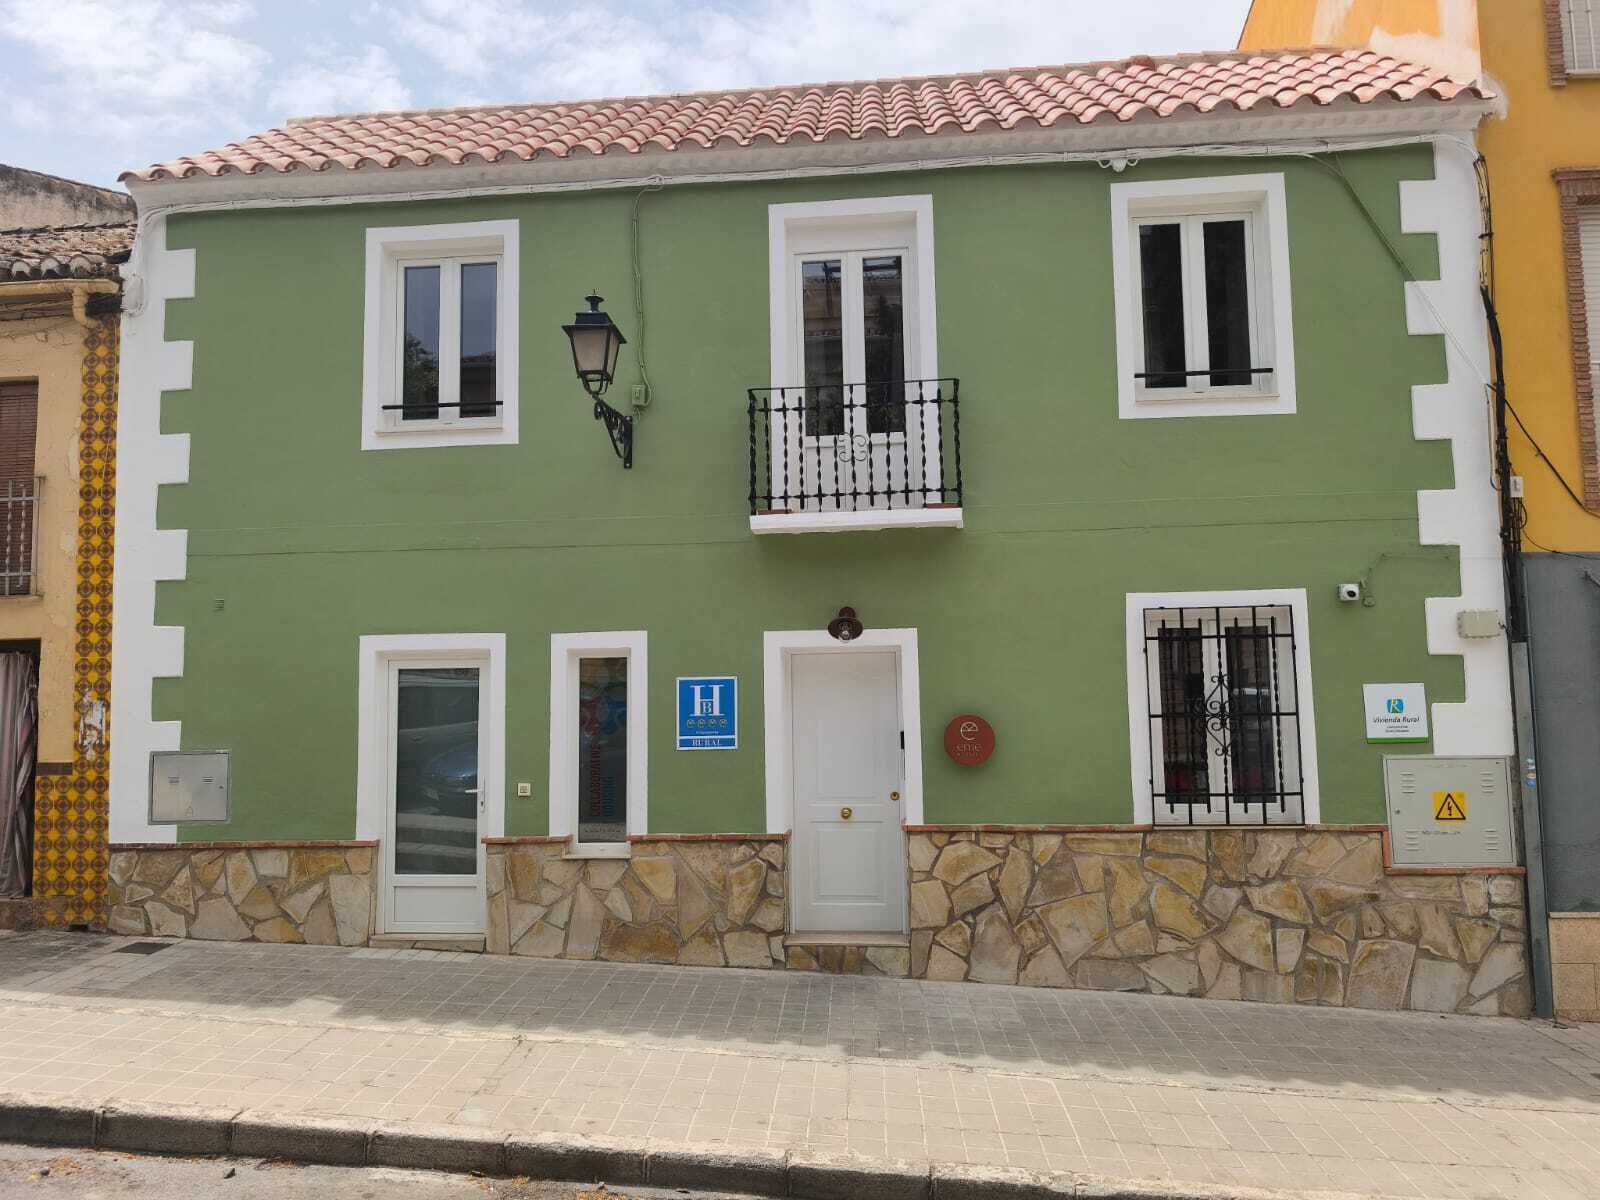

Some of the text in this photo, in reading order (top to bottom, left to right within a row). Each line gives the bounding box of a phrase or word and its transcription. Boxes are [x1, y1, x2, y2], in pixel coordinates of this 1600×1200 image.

[689, 684, 725, 717] H
[1373, 716, 1420, 724] Vivienda Rural
[692, 739, 722, 747] RURAL
